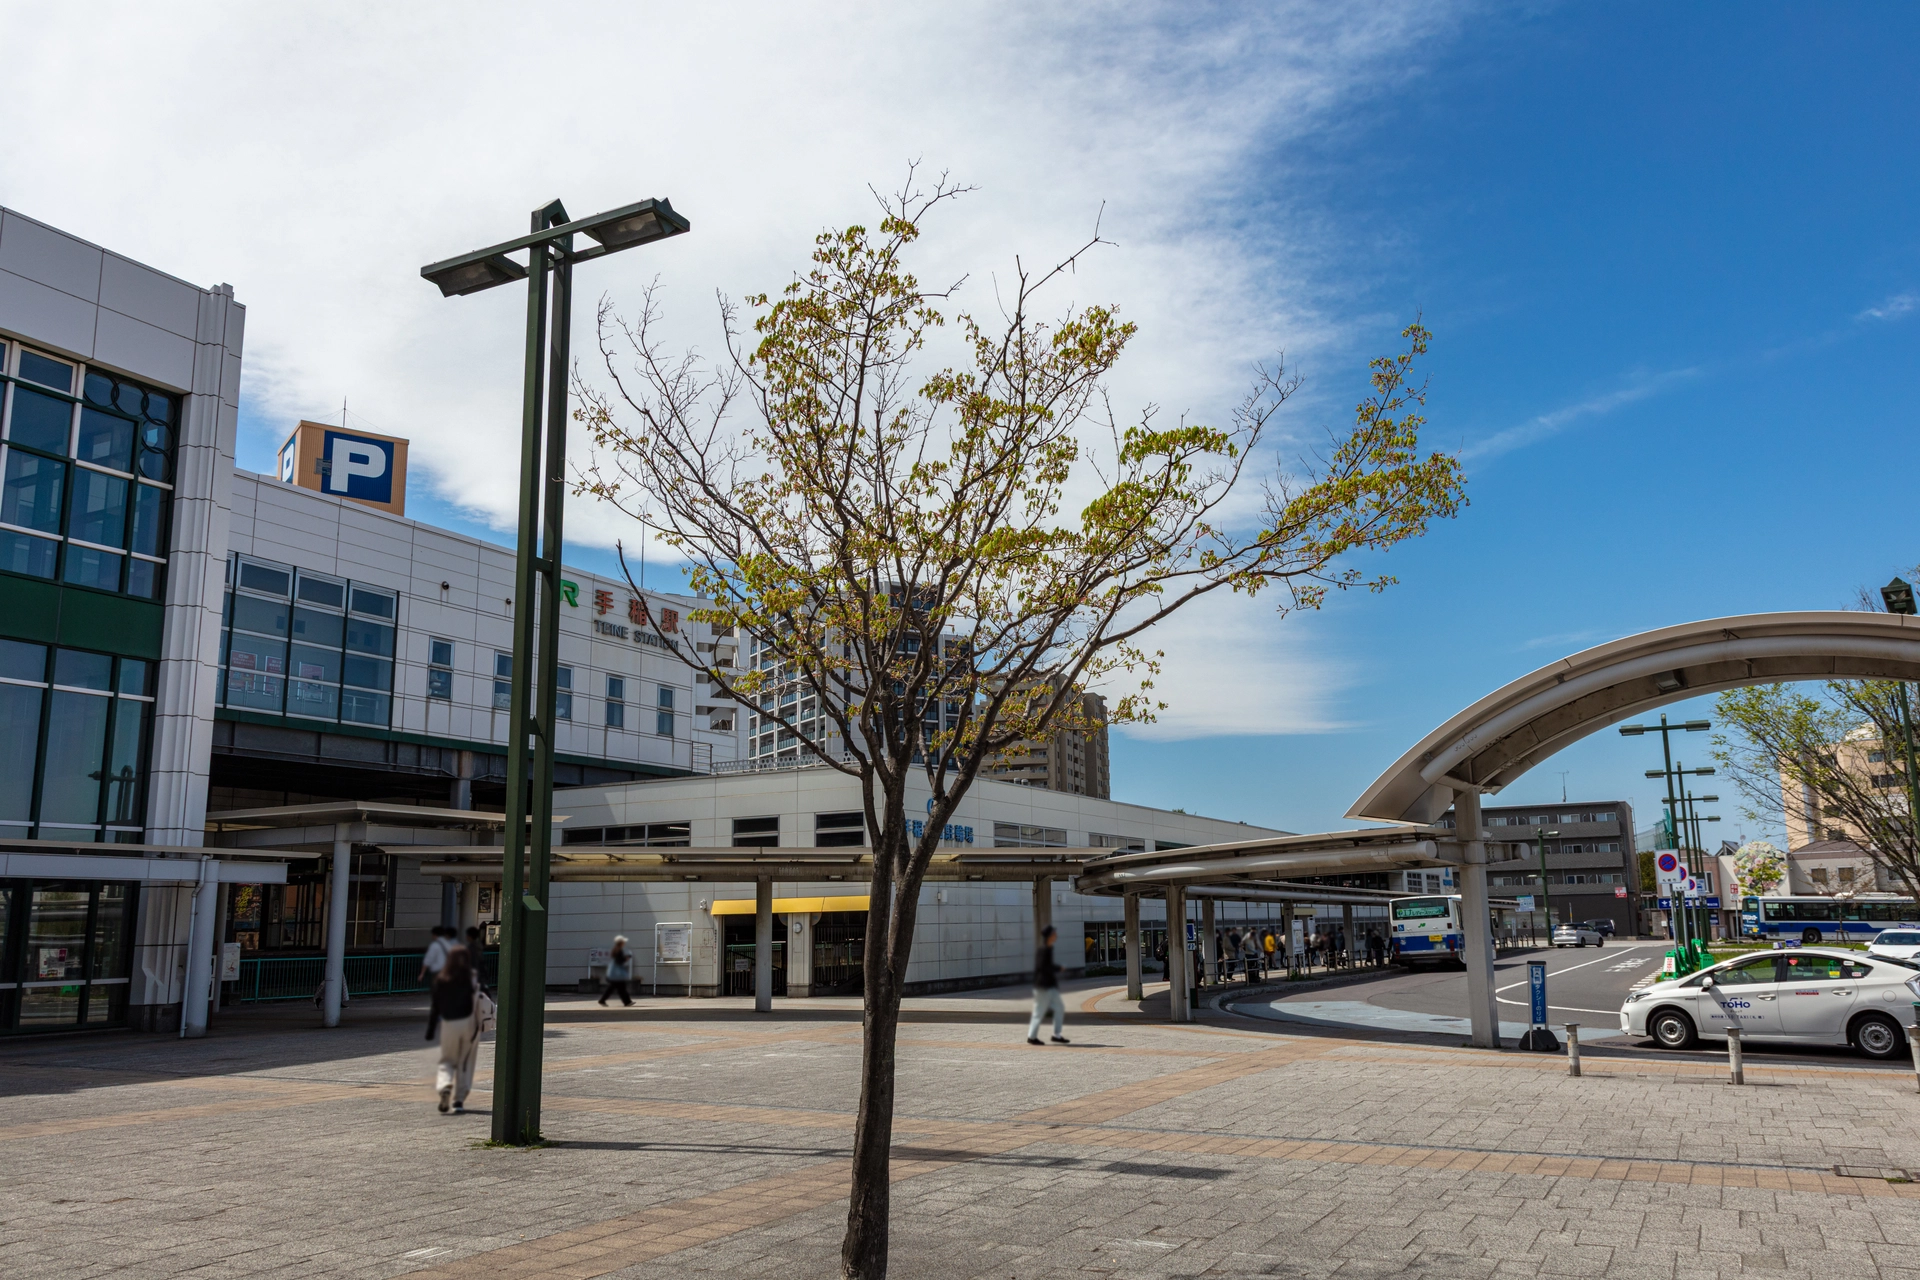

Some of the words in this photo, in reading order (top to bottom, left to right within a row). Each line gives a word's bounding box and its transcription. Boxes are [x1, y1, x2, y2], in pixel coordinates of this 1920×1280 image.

[282, 443, 295, 483] P
[330, 437, 387, 493] P
[594, 589, 679, 634] 手稲駅
[595, 620, 629, 640] TEINE
